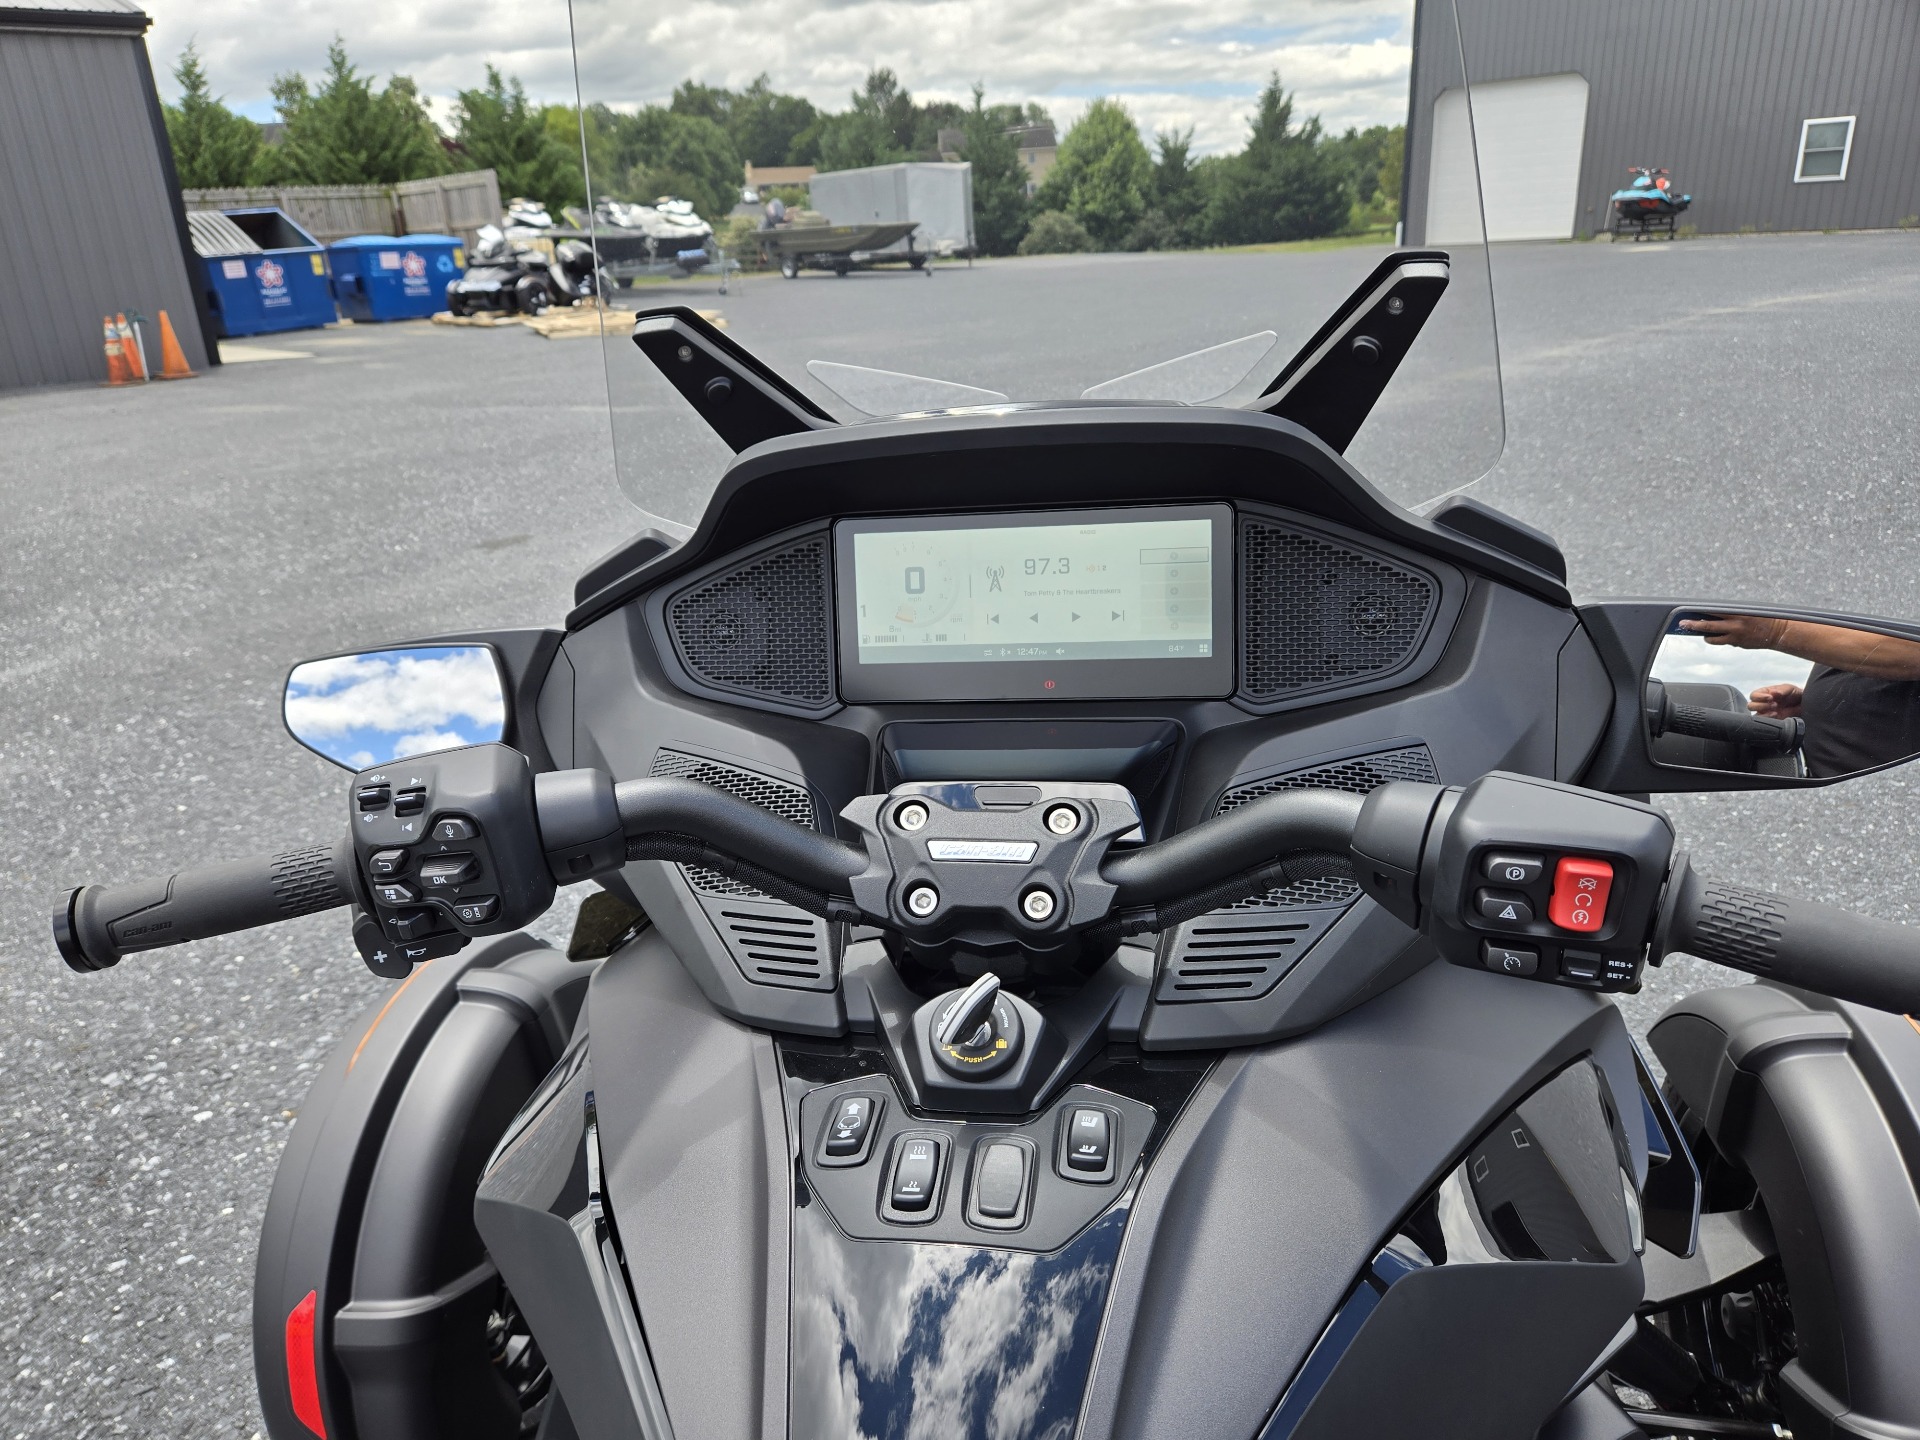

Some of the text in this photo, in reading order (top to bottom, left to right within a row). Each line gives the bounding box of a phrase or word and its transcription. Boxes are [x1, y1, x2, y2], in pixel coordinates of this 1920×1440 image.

[1024, 557, 1070, 575] 97.3
[904, 566, 926, 595] 0
[1038, 589, 1055, 597] Petty
[1075, 588, 1121, 596] Heartbreakers
[860, 604, 867, 618] 1
[432, 875, 448, 885] OK
[963, 1056, 983, 1064] PUSH
